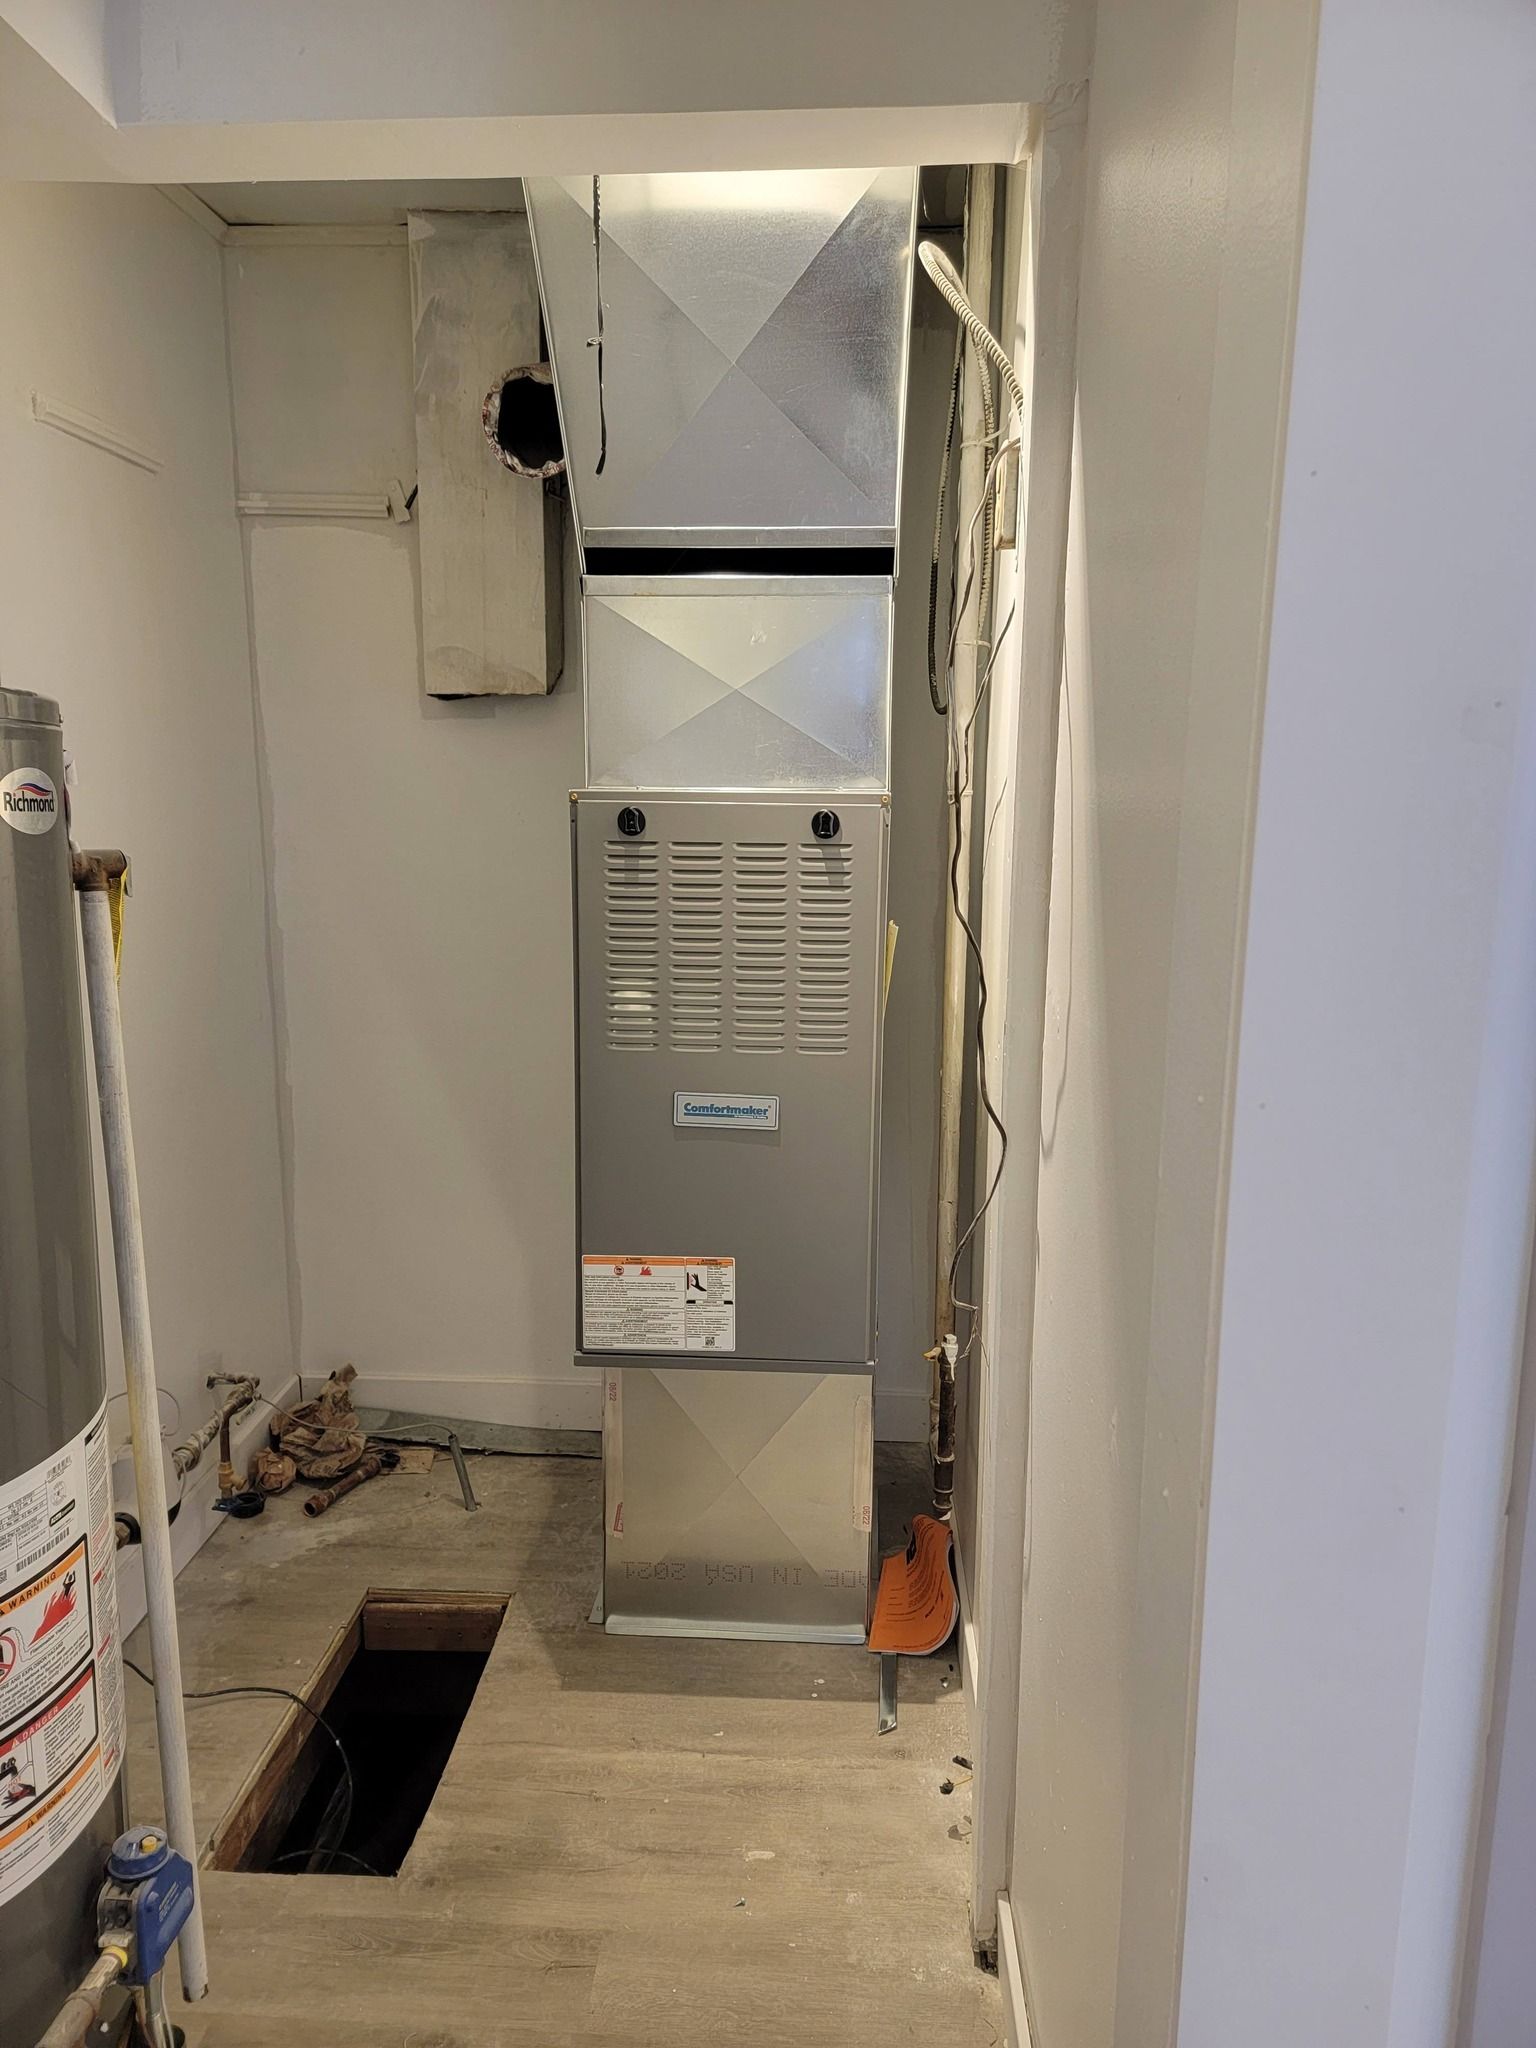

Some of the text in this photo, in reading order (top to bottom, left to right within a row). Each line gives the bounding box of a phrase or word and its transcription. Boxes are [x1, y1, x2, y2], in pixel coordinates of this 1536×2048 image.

[3, 790, 54, 813] Richmond
[683, 1102, 769, 1117] Comfortmaker
[608, 1382, 617, 1401] 08/22
[622, 1561, 686, 1580] 2021
[705, 1563, 753, 1586] USA
[773, 1567, 802, 1585] IN
[8, 1571, 57, 1609] WARNING
[22, 1706, 59, 1740] DANGER
